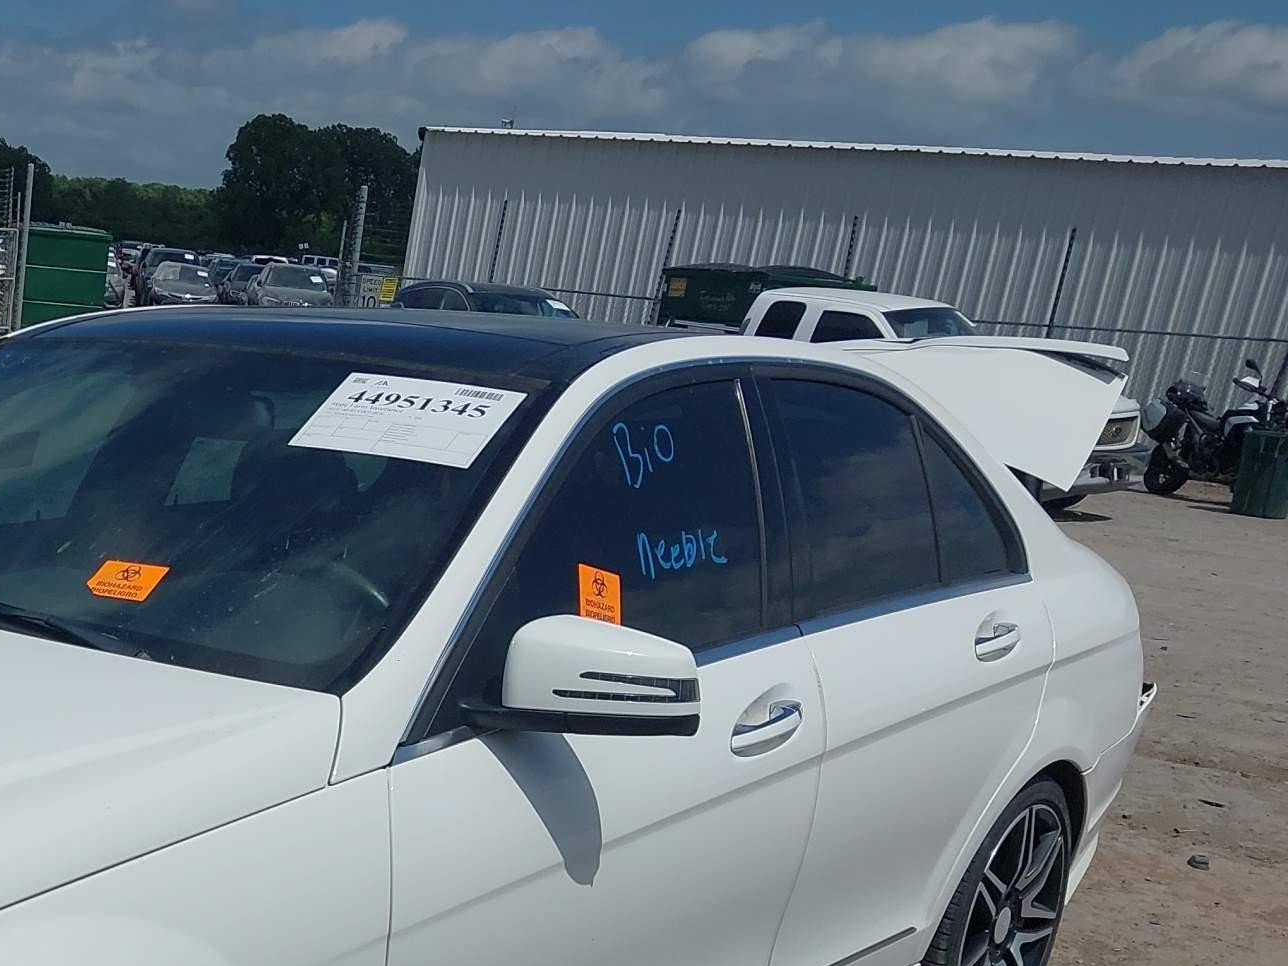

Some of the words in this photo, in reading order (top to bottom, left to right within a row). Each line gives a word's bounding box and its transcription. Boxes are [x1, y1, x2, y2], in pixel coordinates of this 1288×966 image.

[347, 390, 492, 419] 44951345
[95, 580, 144, 592] BIOHAZARD
[585, 598, 616, 613] BIOHAZARD
